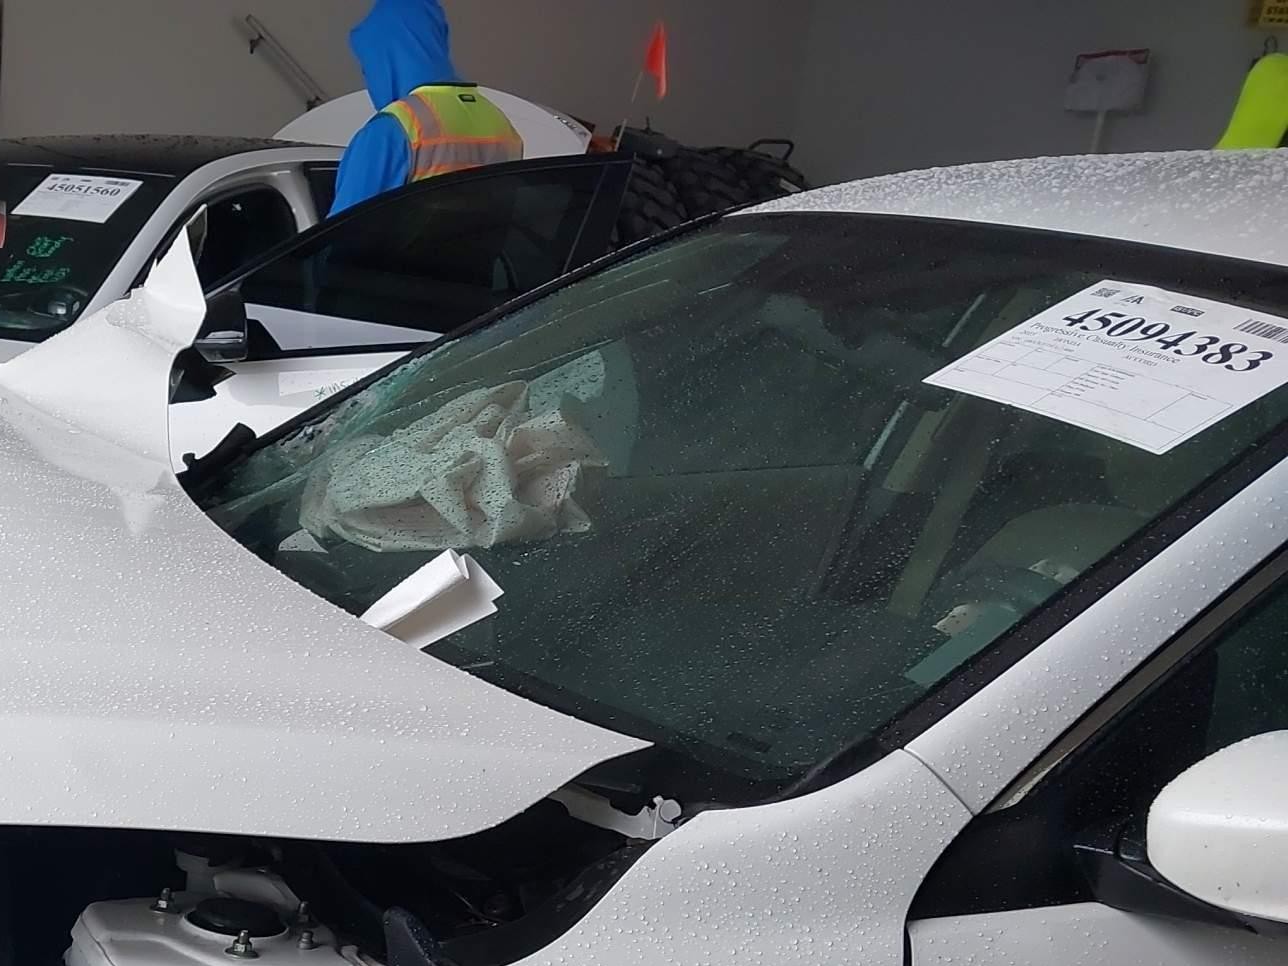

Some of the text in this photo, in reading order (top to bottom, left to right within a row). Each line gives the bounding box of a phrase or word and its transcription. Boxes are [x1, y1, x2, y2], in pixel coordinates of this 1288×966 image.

[47, 183, 120, 196] 45051560
[1030, 322, 1086, 338] Progressive
[1086, 335, 1126, 350] Casualty
[1129, 345, 1181, 364] Insurance
[1062, 308, 1273, 372] 45094383
